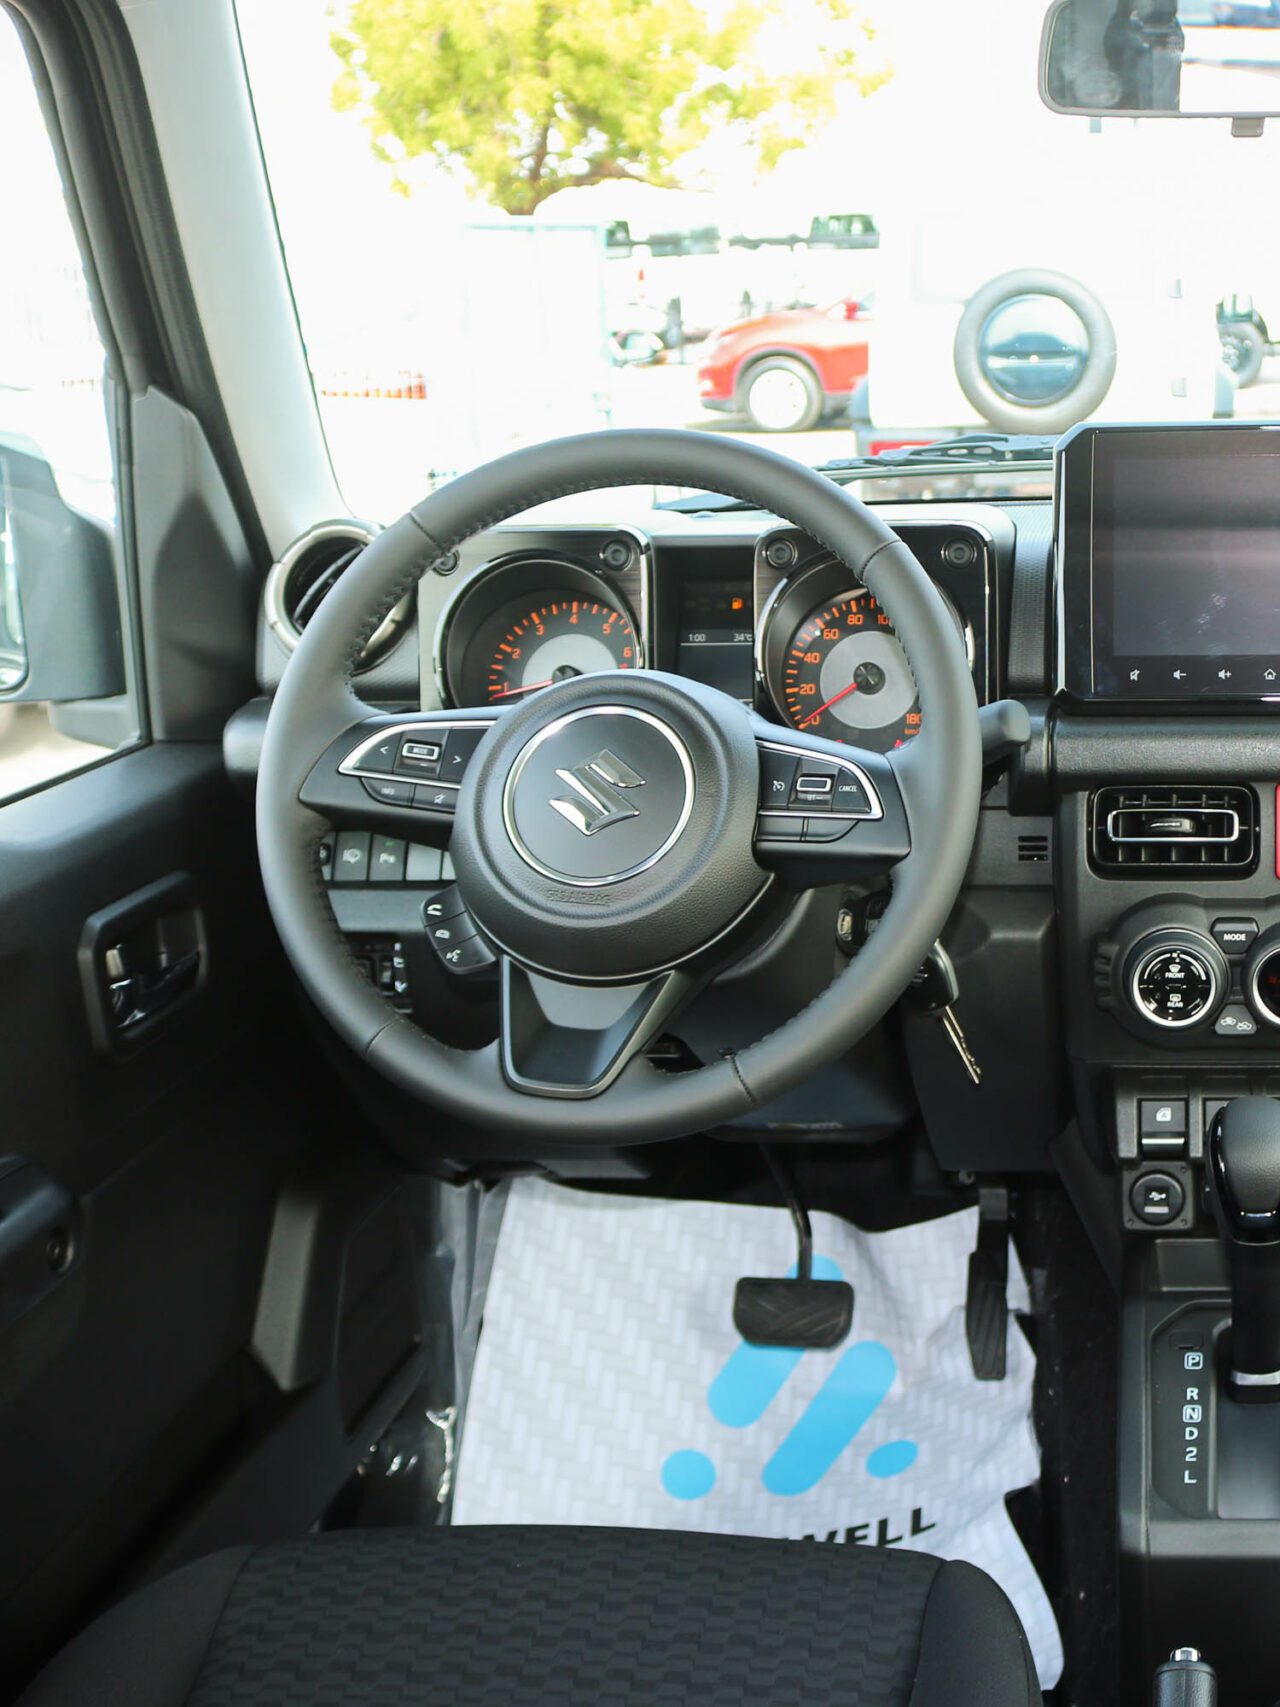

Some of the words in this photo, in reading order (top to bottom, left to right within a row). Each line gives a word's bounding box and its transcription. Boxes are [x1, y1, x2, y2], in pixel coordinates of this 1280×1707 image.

[569, 614, 579, 625] 4
[847, 614, 864, 626] 80
[535, 625, 545, 636] 3
[602, 623, 612, 635] 5
[823, 629, 840, 640] 60
[688, 633, 706, 642] 1:00
[512, 648, 521, 659] 2
[623, 646, 633, 658] 6
[804, 653, 821, 664] 40
[799, 684, 816, 695] 20
[1223, 932, 1247, 943] MODE
[1186, 1387, 1199, 1401] R
[1185, 1426, 1198, 1440] D
[1185, 1447, 1197, 1462] 2
[1184, 1470, 1197, 1485] L
